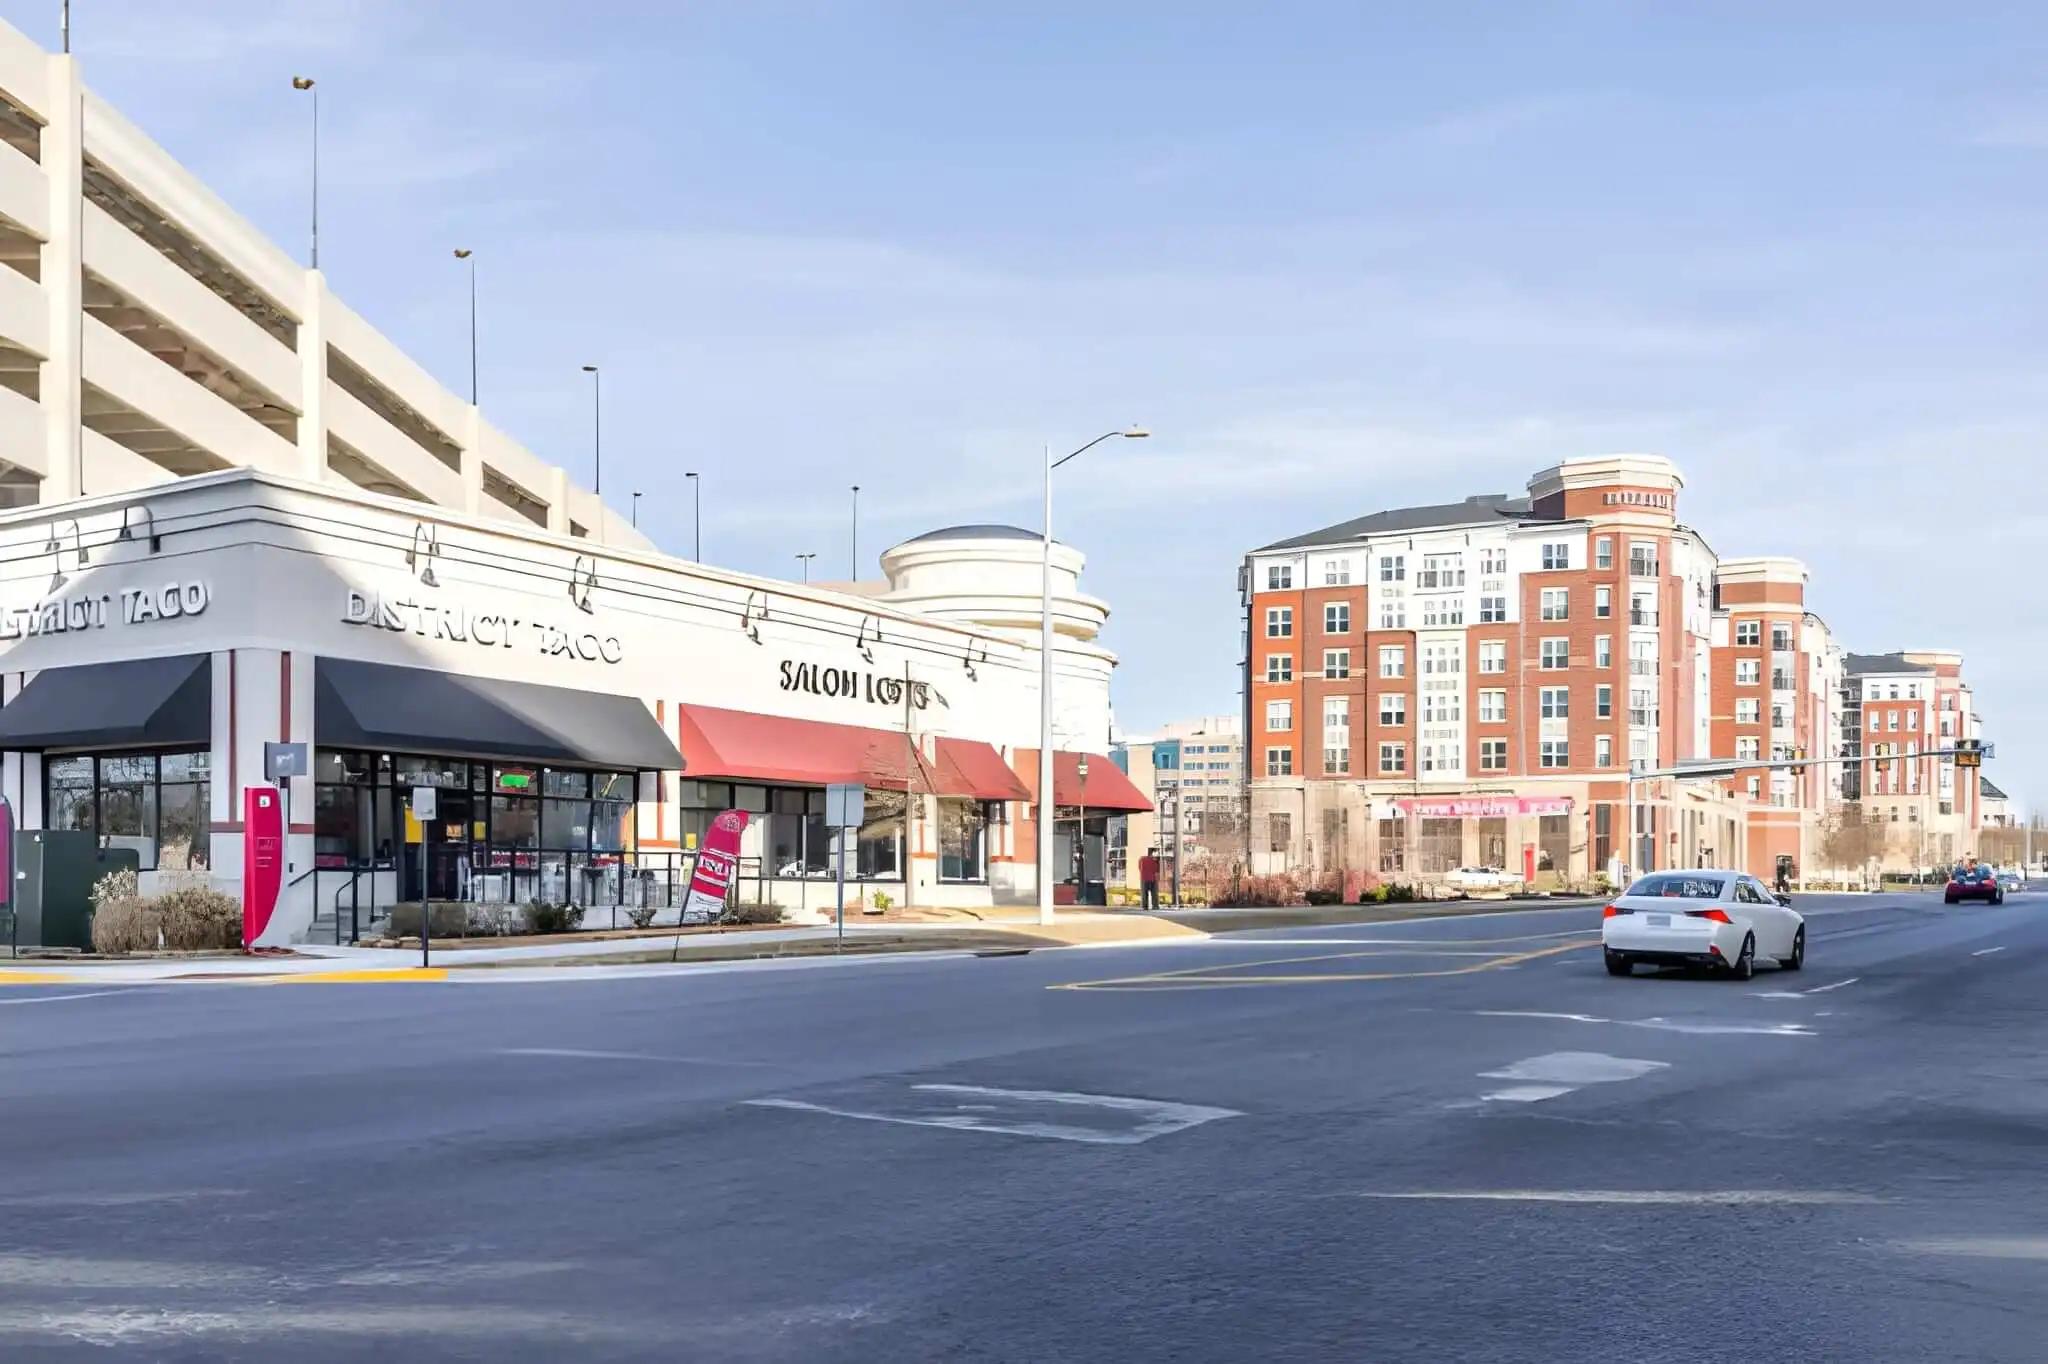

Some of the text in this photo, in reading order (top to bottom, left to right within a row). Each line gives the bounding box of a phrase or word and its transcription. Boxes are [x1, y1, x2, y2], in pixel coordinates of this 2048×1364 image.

[120, 580, 209, 626] TACO
[341, 588, 623, 665] DISTRICT TACO
[780, 659, 858, 699] SALON
